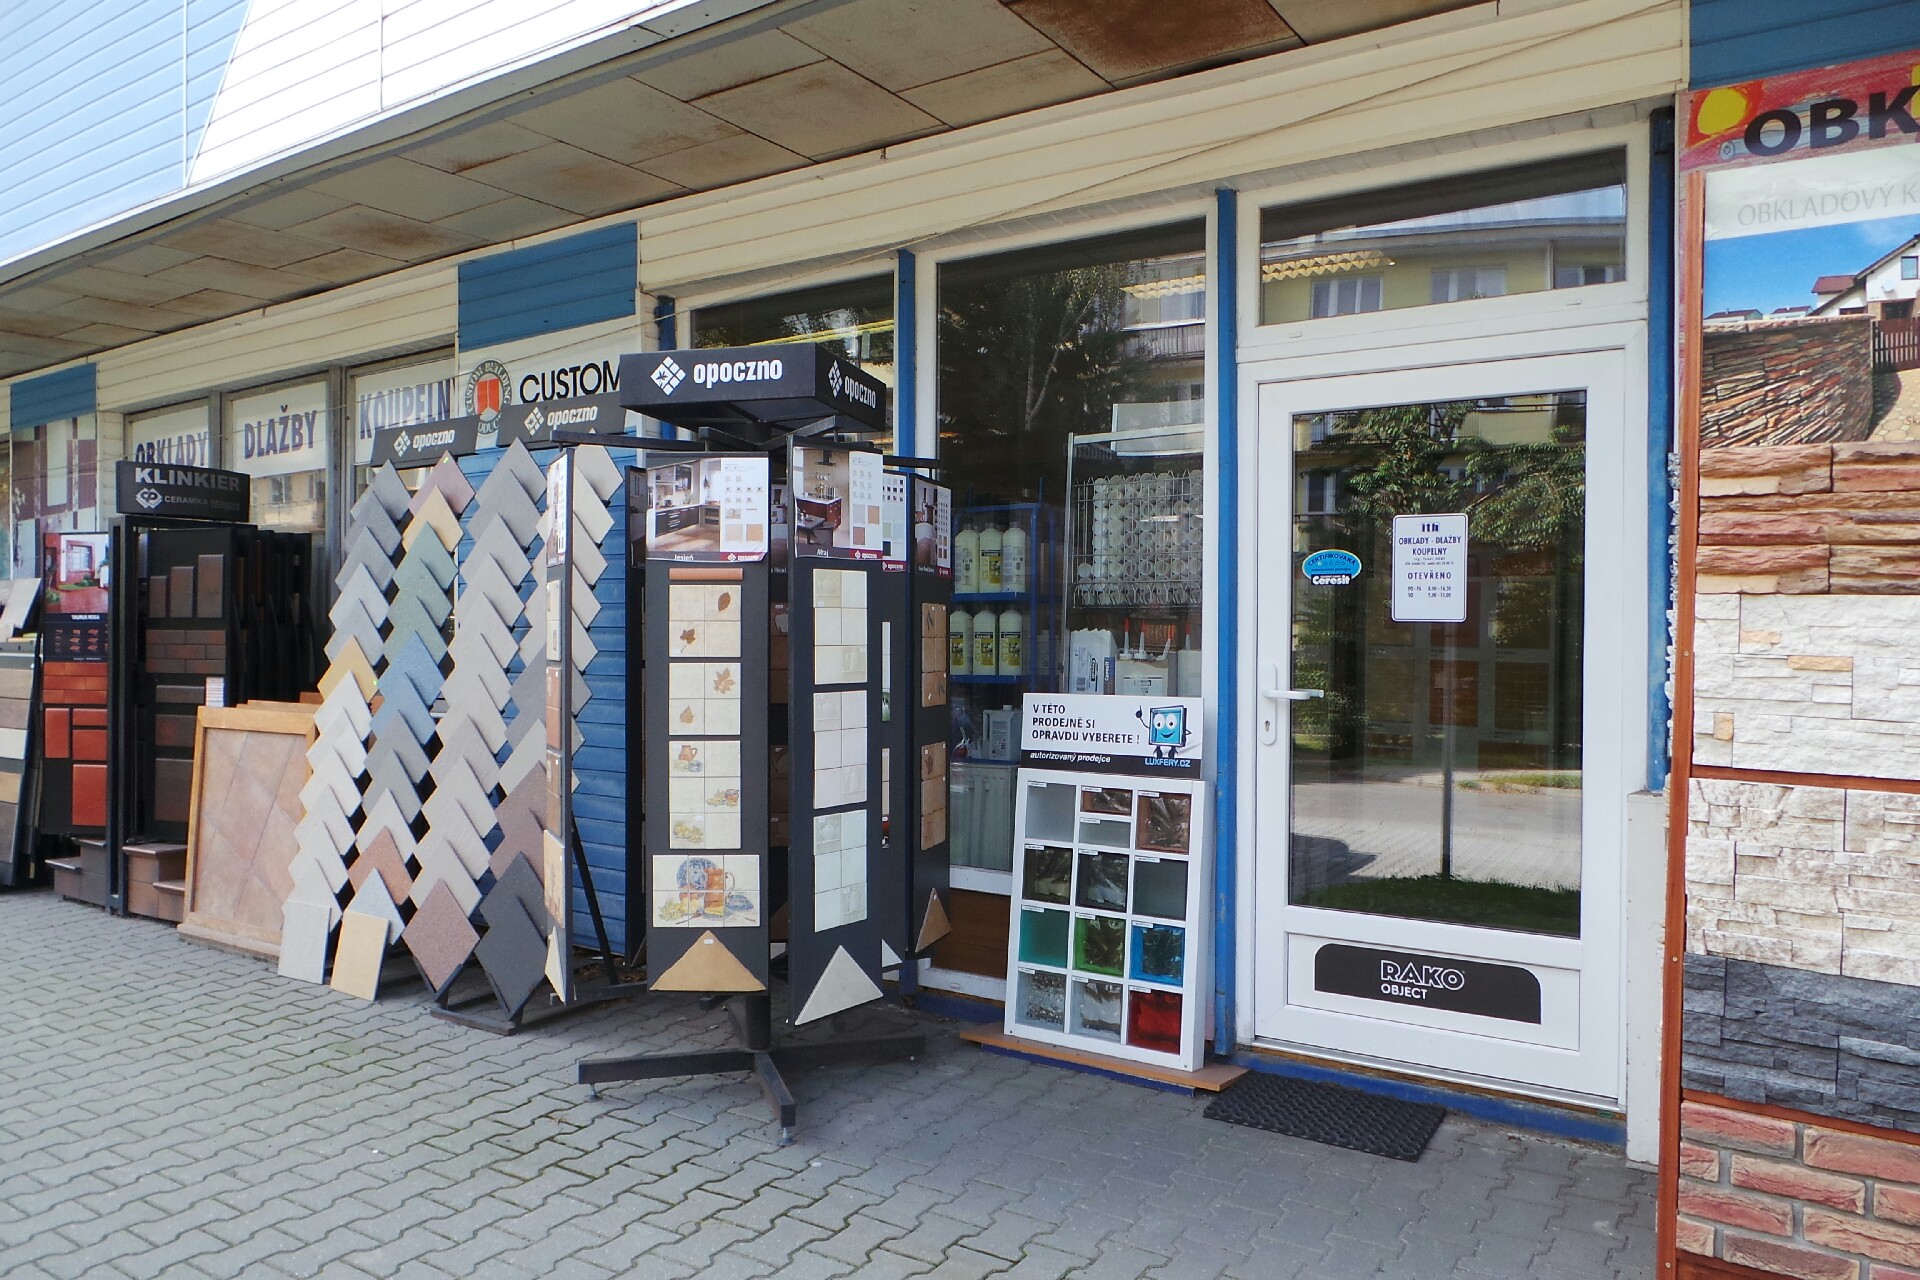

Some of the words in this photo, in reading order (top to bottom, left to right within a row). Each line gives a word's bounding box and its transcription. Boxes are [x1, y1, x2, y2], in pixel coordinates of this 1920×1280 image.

[1744, 84, 1920, 156] OBK
[1738, 181, 1894, 225] OBKLADOVÝ
[520, 361, 620, 404] CUSTOM
[693, 358, 783, 389] opoczno
[844, 374, 876, 409] opoczno
[359, 377, 456, 440] KOUPELN
[547, 406, 598, 430] opoczno
[244, 405, 317, 459] DLAŽBY
[413, 430, 455, 452] opoczno
[135, 431, 208, 467] OBKLADY
[135, 467, 240, 492] KLINKIER
[1398, 537, 1429, 545] OBKLADY
[1435, 534, 1461, 543] DLAŽBY
[1312, 574, 1350, 585] Ceresit
[1407, 570, 1452, 579] OTEVŘENO
[1033, 704, 1040, 714] V
[1042, 702, 1065, 714] TÉTO
[1032, 716, 1083, 728] PRODEJNĚ
[1085, 718, 1095, 729] SI
[1032, 729, 1079, 741] OPRAVDU
[1082, 731, 1133, 744] VYBERETE
[1029, 752, 1077, 763] autorizovaný
[1077, 754, 1111, 763] prodejce
[1144, 757, 1191, 767] LUXFERY.CZ
[1380, 959, 1465, 991] RAKO
[1380, 983, 1428, 1000] OBJECT
